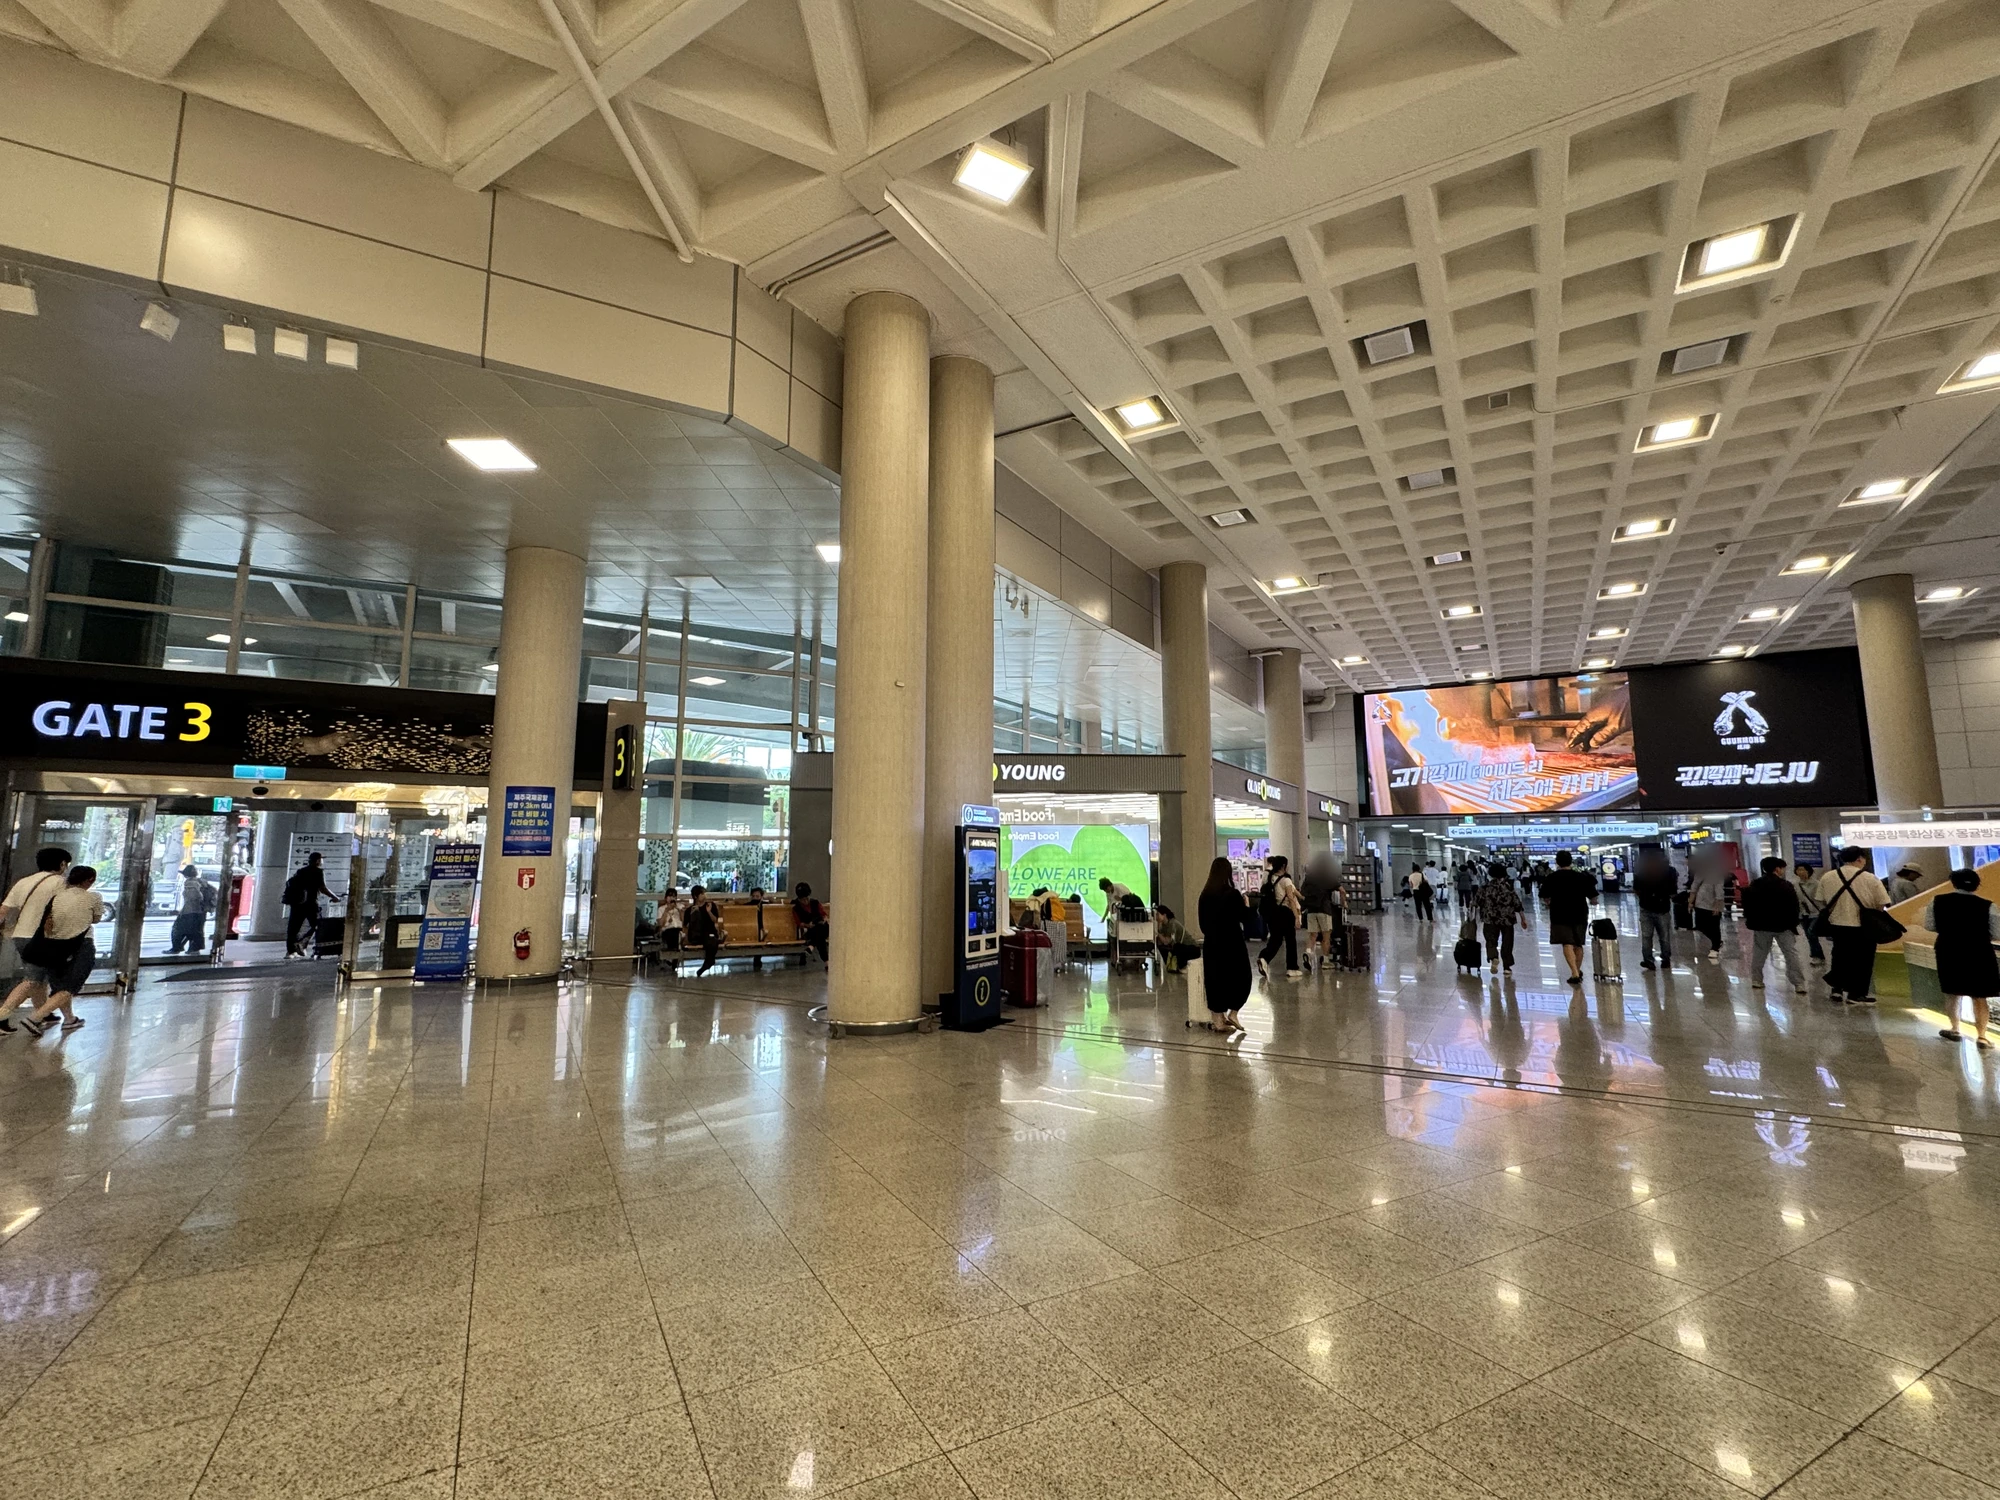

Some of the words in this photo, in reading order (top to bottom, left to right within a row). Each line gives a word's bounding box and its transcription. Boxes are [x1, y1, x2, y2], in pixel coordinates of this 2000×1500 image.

[32, 700, 168, 740] GATE
[178, 702, 212, 742] 3
[615, 738, 625, 777] 3
[1000, 764, 1066, 781] YOUNG
[1389, 761, 1468, 788] 고기깡패
[1472, 761, 1525, 778] 데이비드
[1528, 759, 1544, 772] 리
[1676, 766, 1742, 781] 고기깡패
[1746, 761, 1819, 785] JEJU
[1852, 829, 1945, 840] 제주공항특화상품
[1037, 867, 1063, 880] WE
[1066, 867, 1096, 880] ARE
